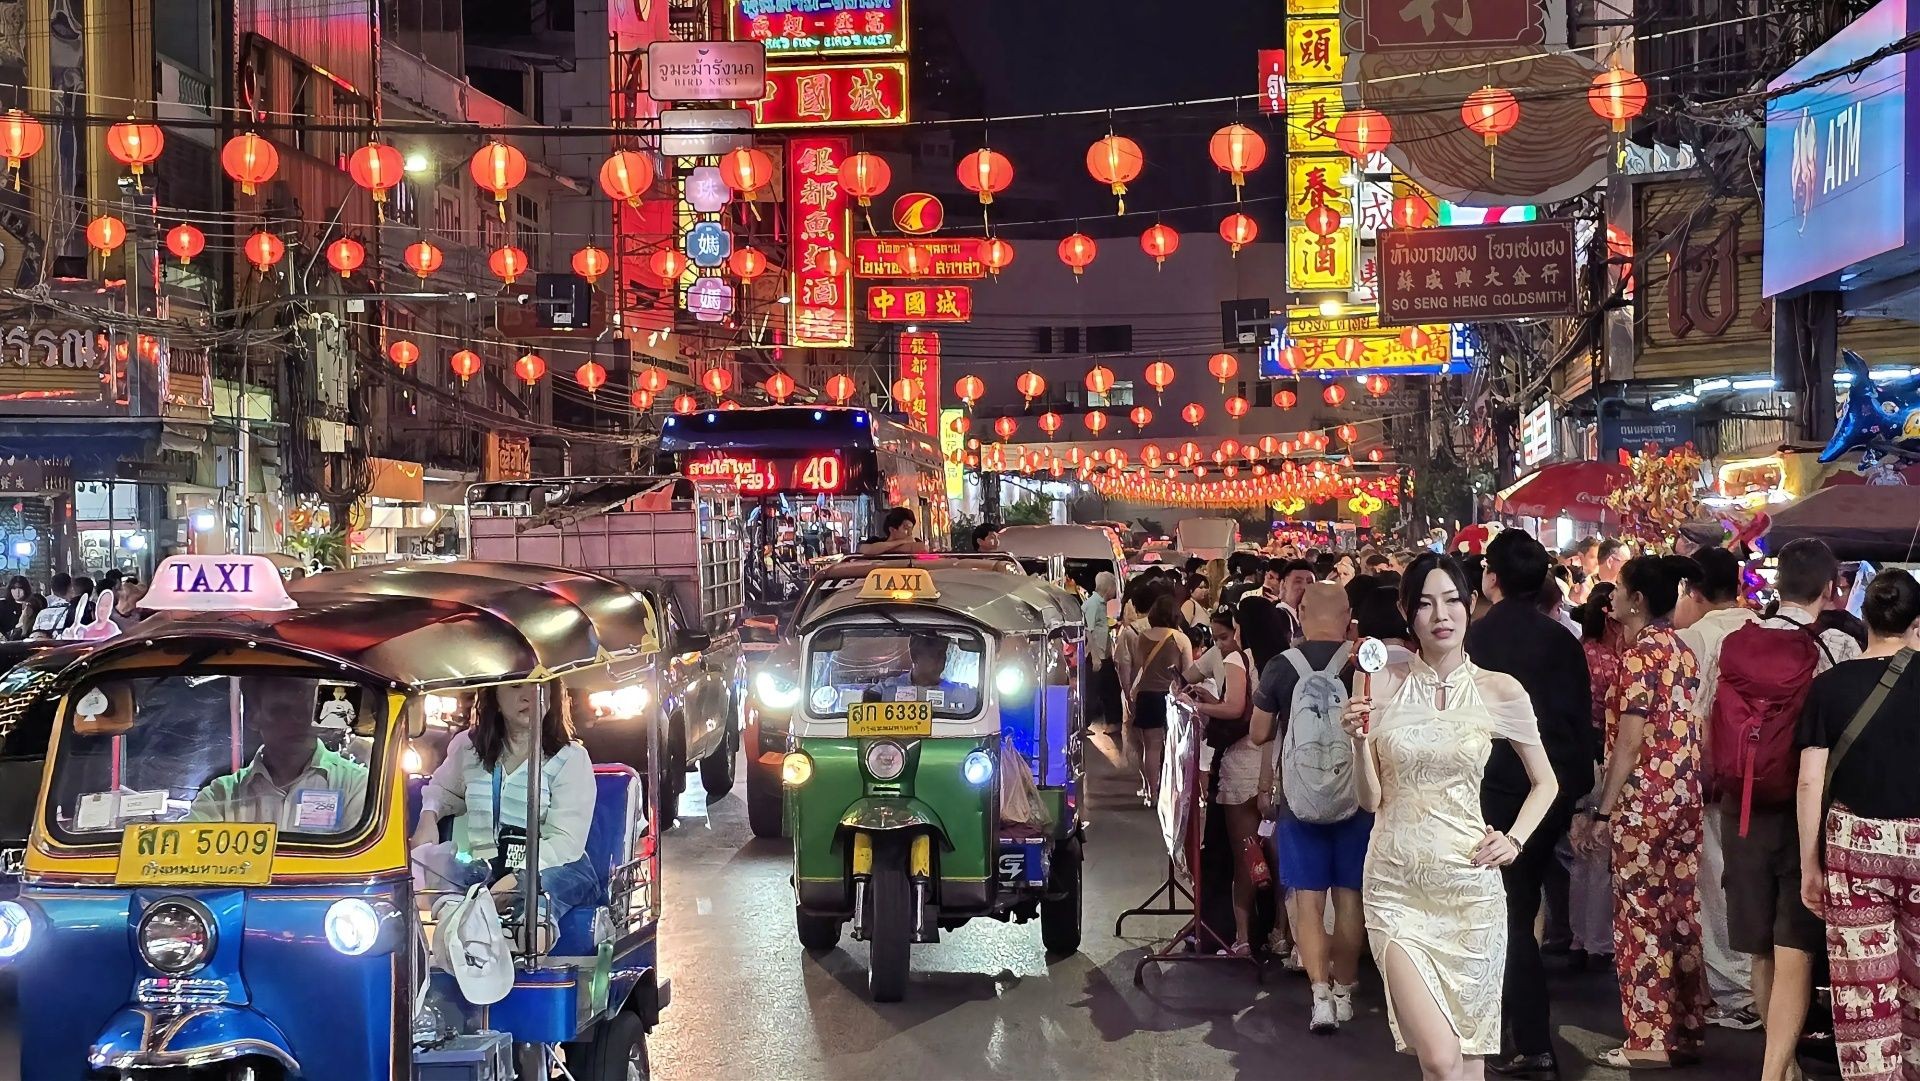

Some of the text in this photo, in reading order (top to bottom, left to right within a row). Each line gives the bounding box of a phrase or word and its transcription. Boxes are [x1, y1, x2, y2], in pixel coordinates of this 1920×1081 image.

[659, 59, 754, 81] จูมะม้ารังนก
[709, 78, 738, 86] NEST
[1823, 101, 1862, 195] ATM
[1391, 243, 1477, 264] ห้างขายทอง
[873, 289, 961, 318] 中國城
[1392, 290, 1567, 311] SO SENG HENG GOLDSMITH
[802, 457, 840, 489] 40
[169, 564, 253, 593] TAXI
[872, 574, 921, 591] TAXI
[885, 704, 928, 720] 6338
[197, 830, 268, 855] 5009
